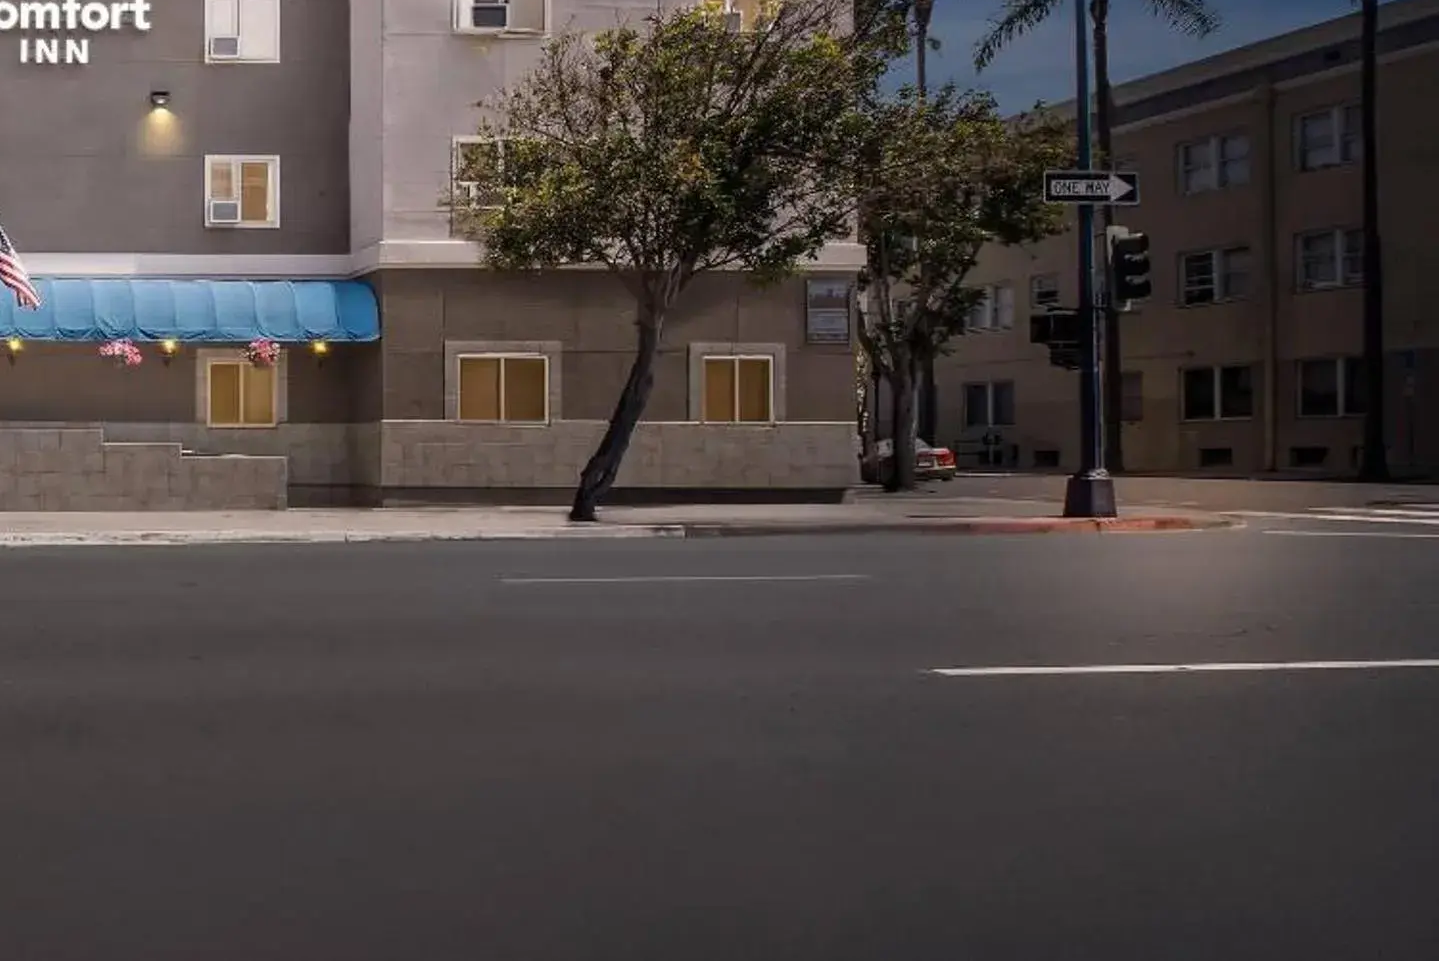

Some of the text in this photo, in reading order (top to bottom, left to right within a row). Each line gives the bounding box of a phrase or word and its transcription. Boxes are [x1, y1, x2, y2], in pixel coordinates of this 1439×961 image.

[20, 39, 89, 64] INN
[1054, 181, 1110, 194] ONE WAY
